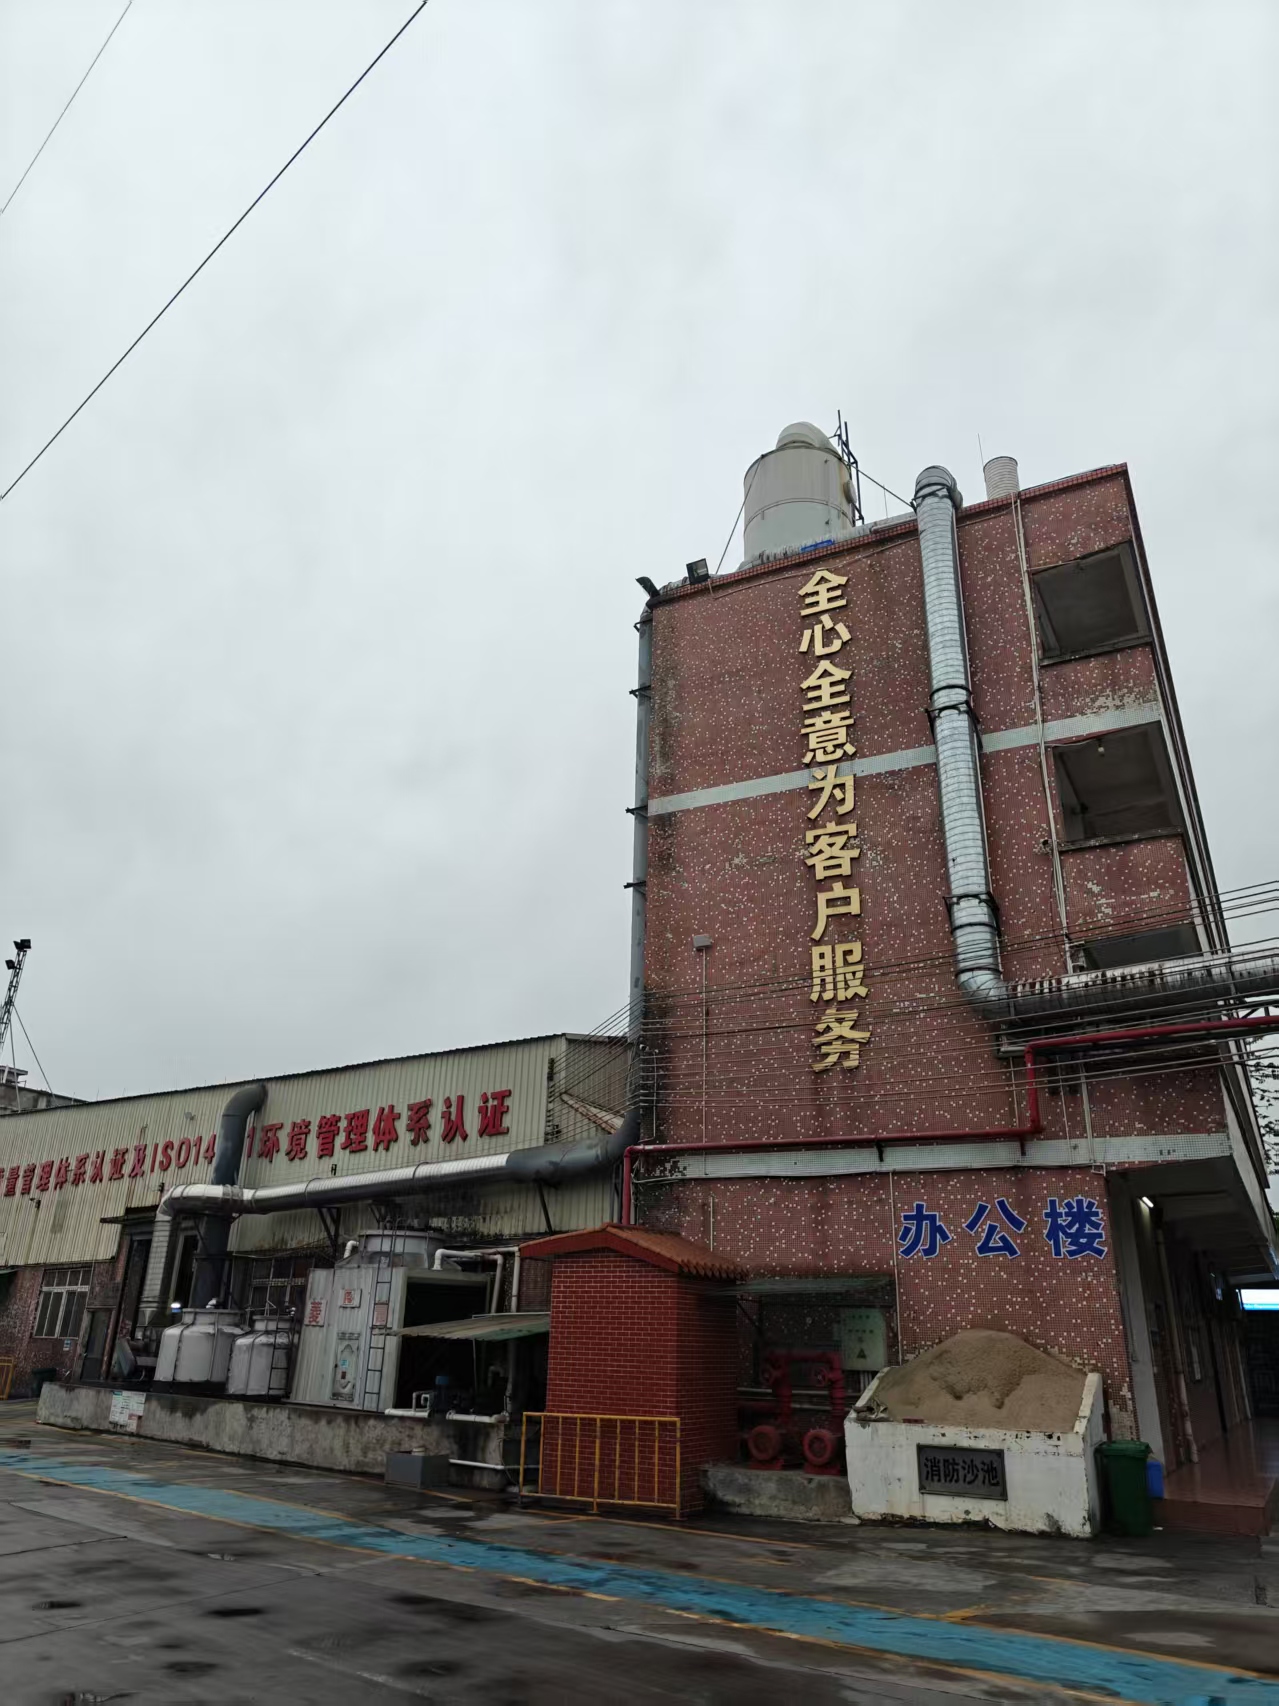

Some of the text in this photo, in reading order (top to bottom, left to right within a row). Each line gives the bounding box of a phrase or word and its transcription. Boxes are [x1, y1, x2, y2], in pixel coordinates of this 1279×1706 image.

[798, 569, 872, 1073] 全心全意为客户服务
[897, 1196, 1108, 1260] 办公楼
[924, 1456, 1001, 1487] 消防沙池
